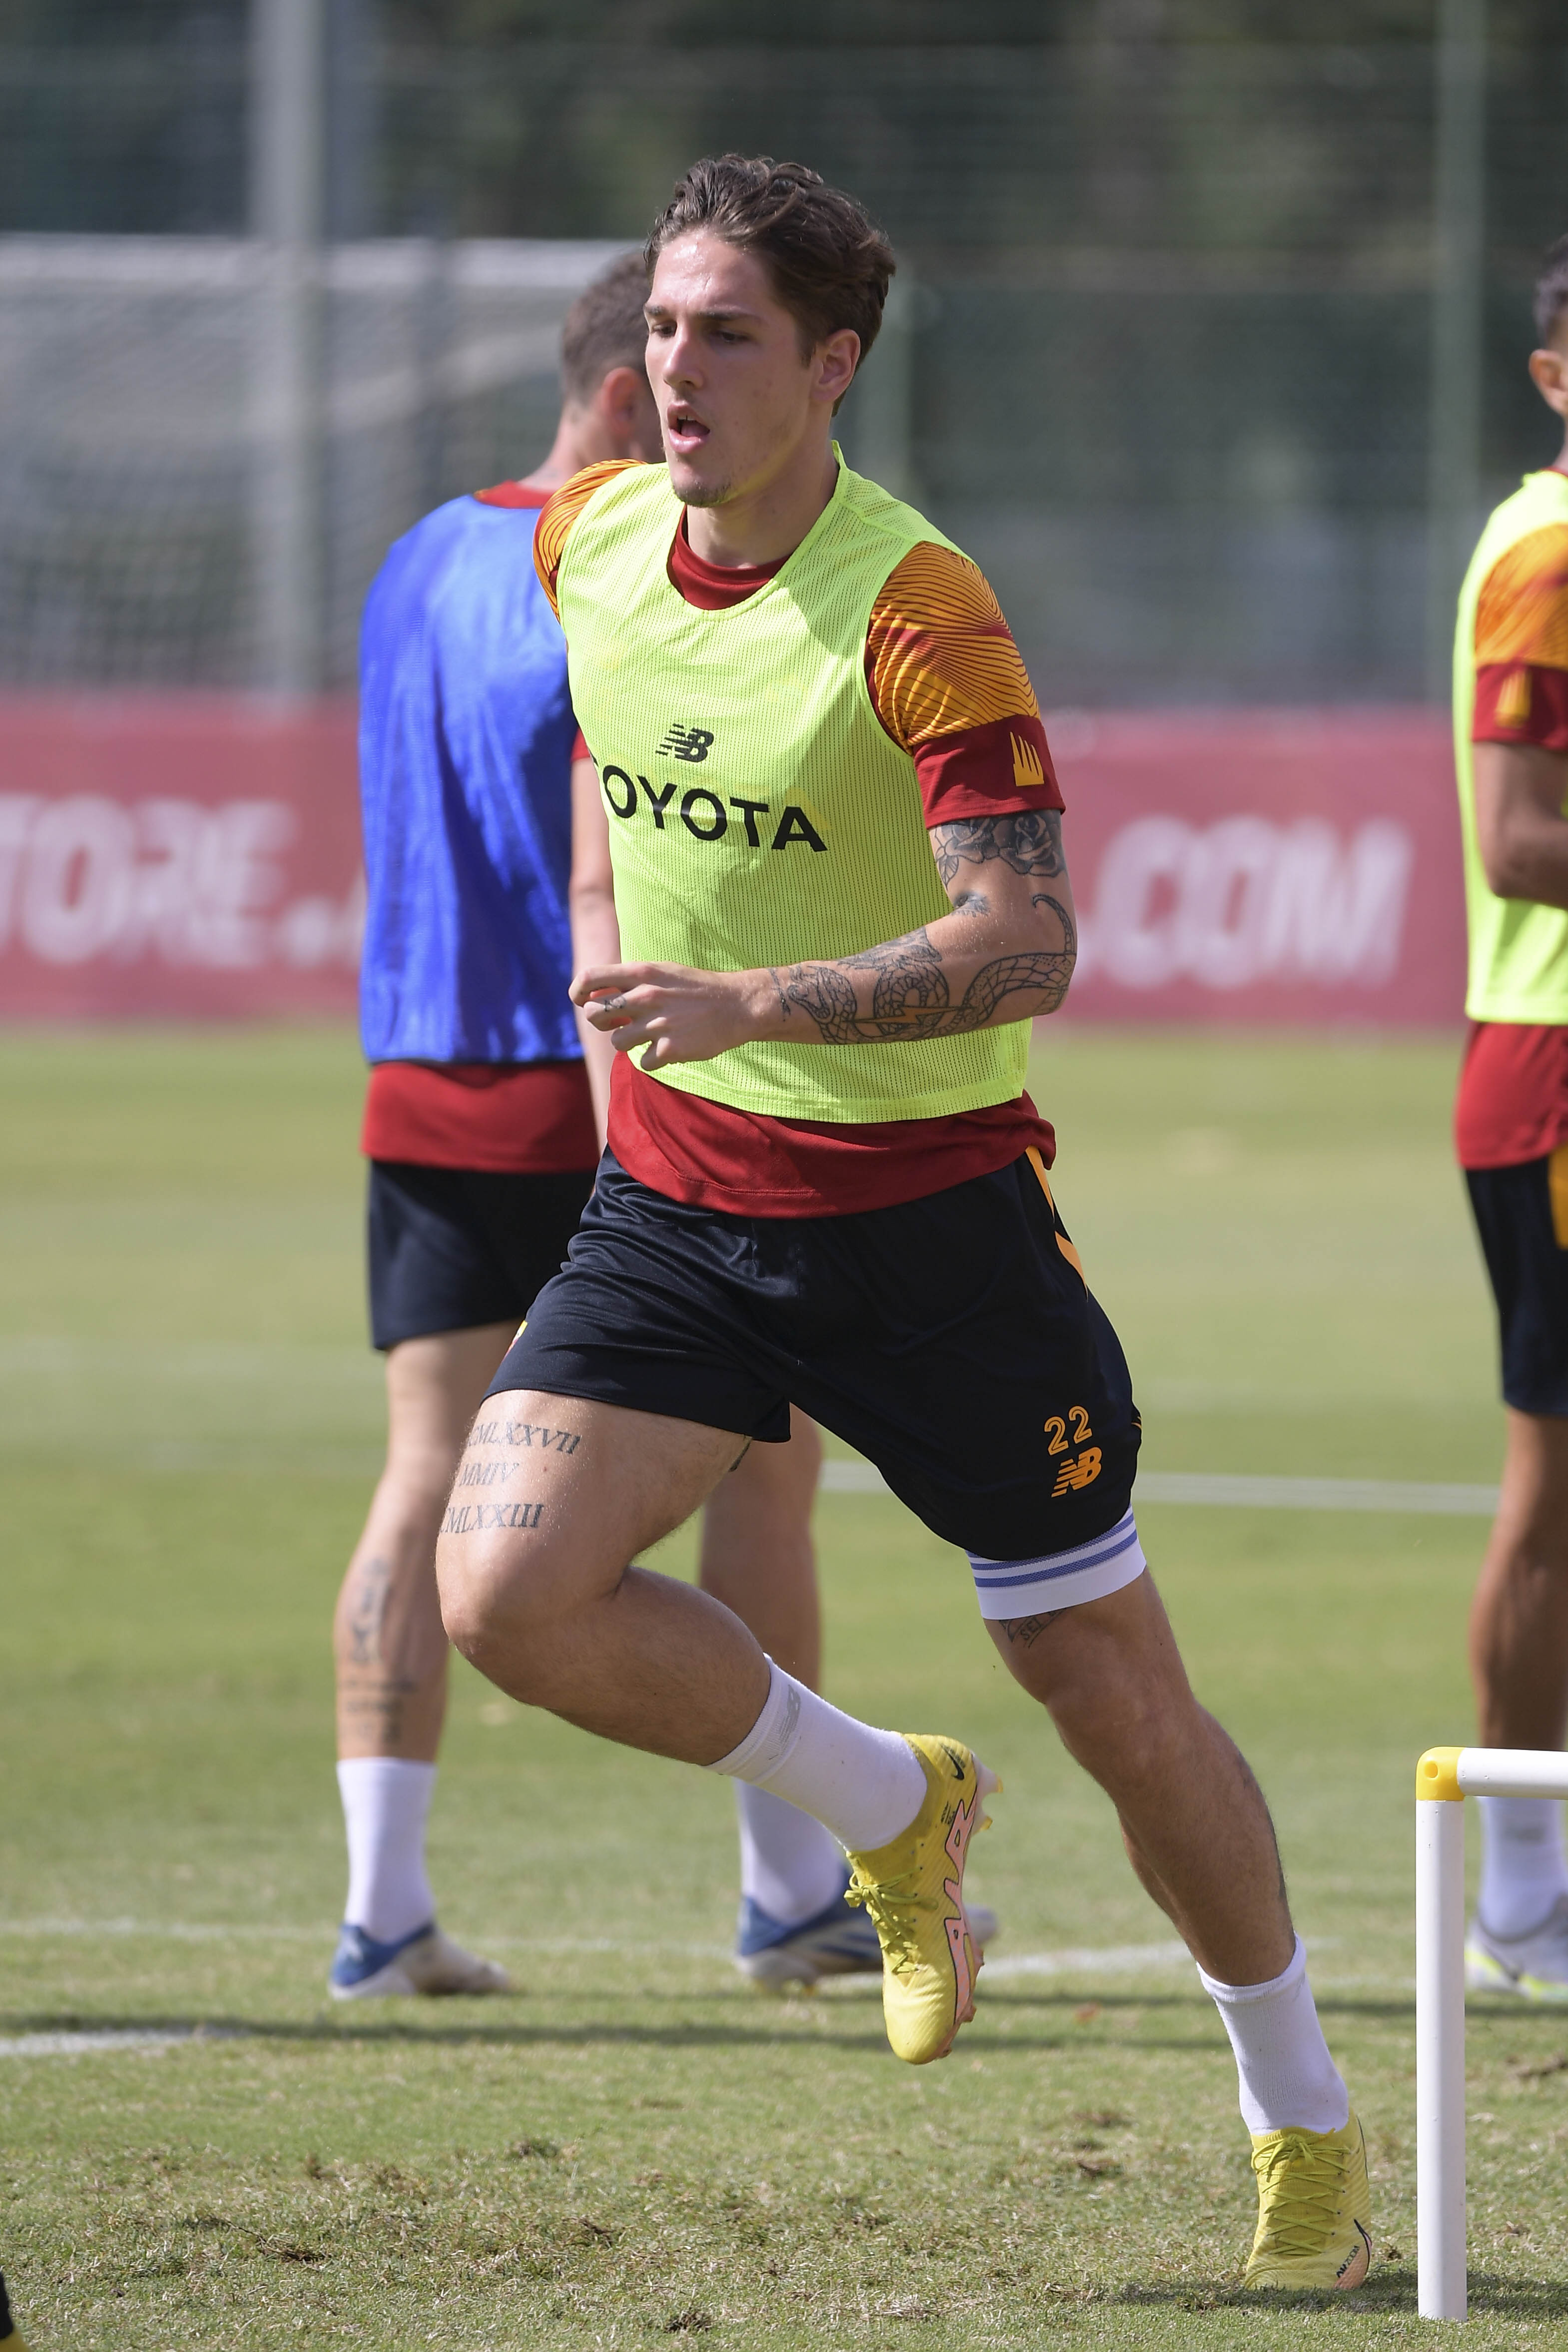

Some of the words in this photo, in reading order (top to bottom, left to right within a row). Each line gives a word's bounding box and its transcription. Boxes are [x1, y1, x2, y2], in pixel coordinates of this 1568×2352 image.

[593, 755, 828, 852] OYOTA
[1044, 1405, 1092, 1456] 22
[1051, 1447, 1102, 1498] NB
